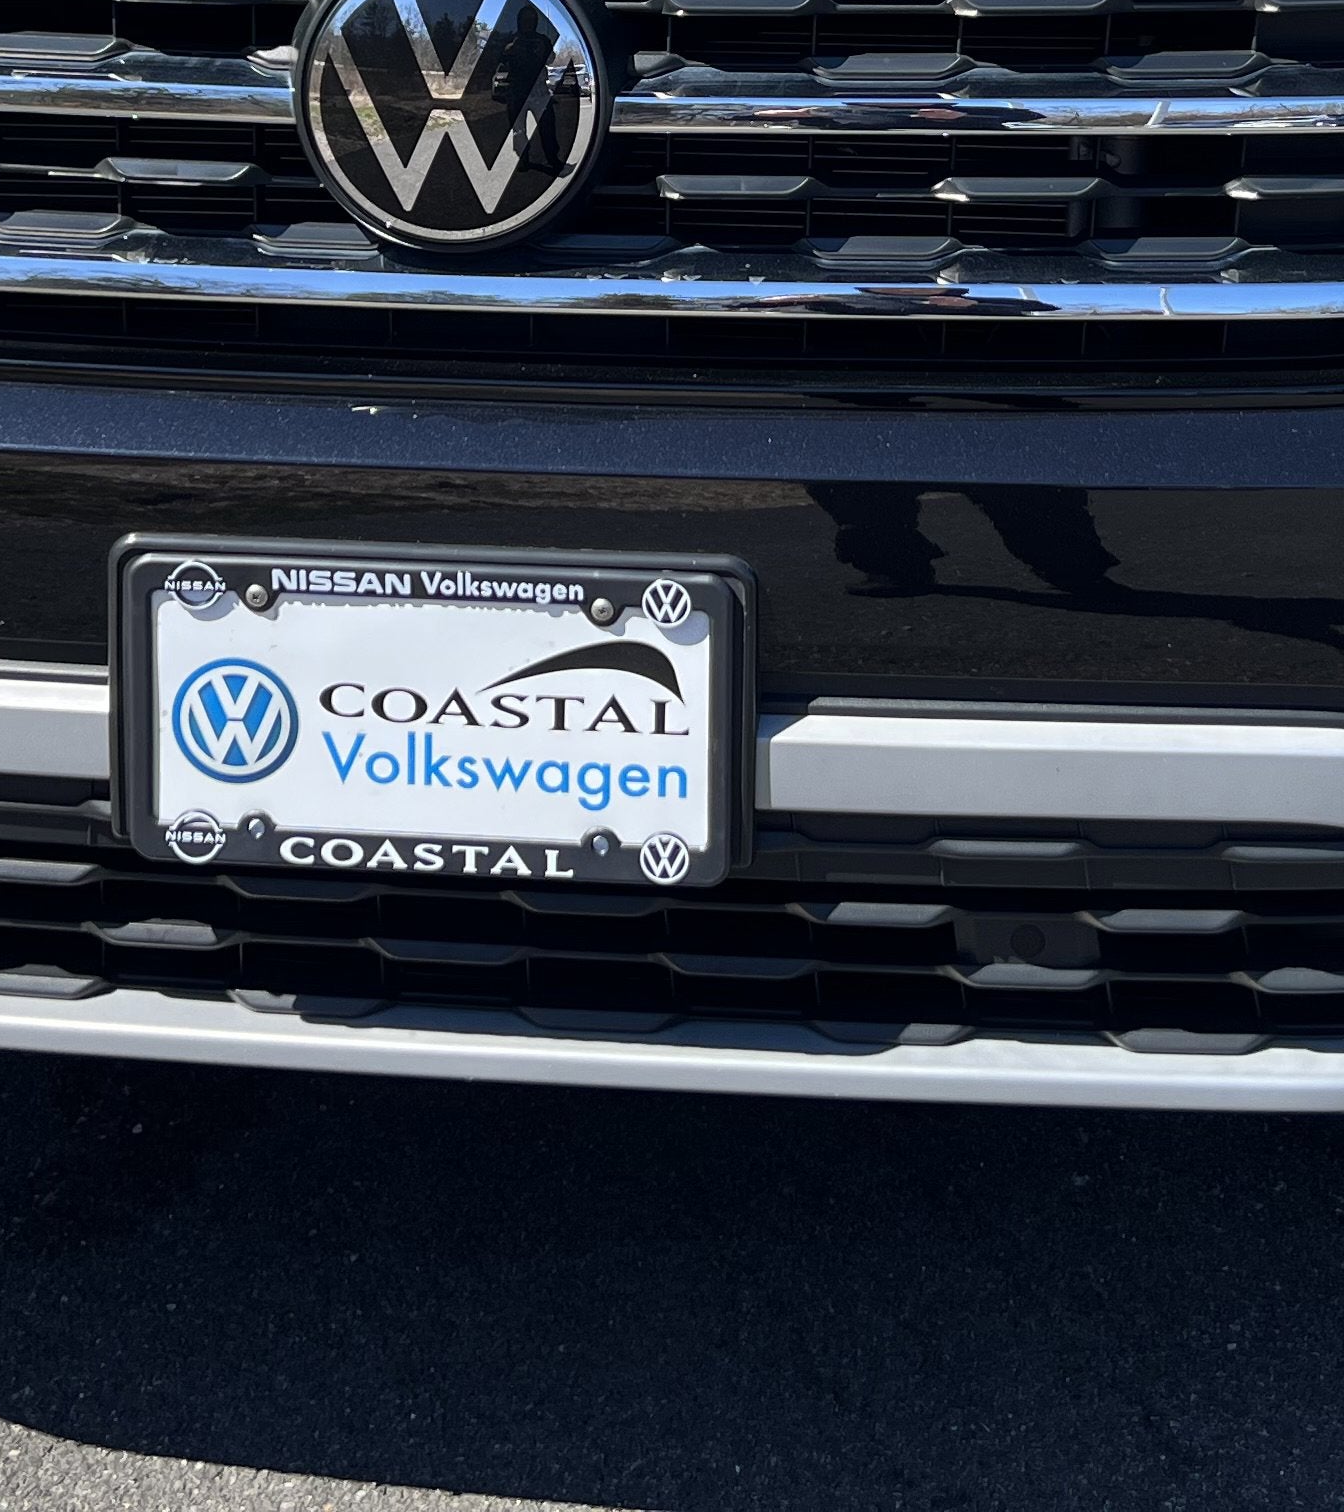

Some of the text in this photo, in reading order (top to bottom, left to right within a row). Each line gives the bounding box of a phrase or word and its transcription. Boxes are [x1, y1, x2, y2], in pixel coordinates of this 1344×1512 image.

[165, 579, 226, 591] NISSAN
[271, 568, 584, 603] NISSAN Volkswagen
[319, 683, 689, 735] COASTAL
[321, 731, 689, 811] Volkswagen
[165, 830, 226, 844] NISSAN
[279, 836, 574, 878] COASTAL
